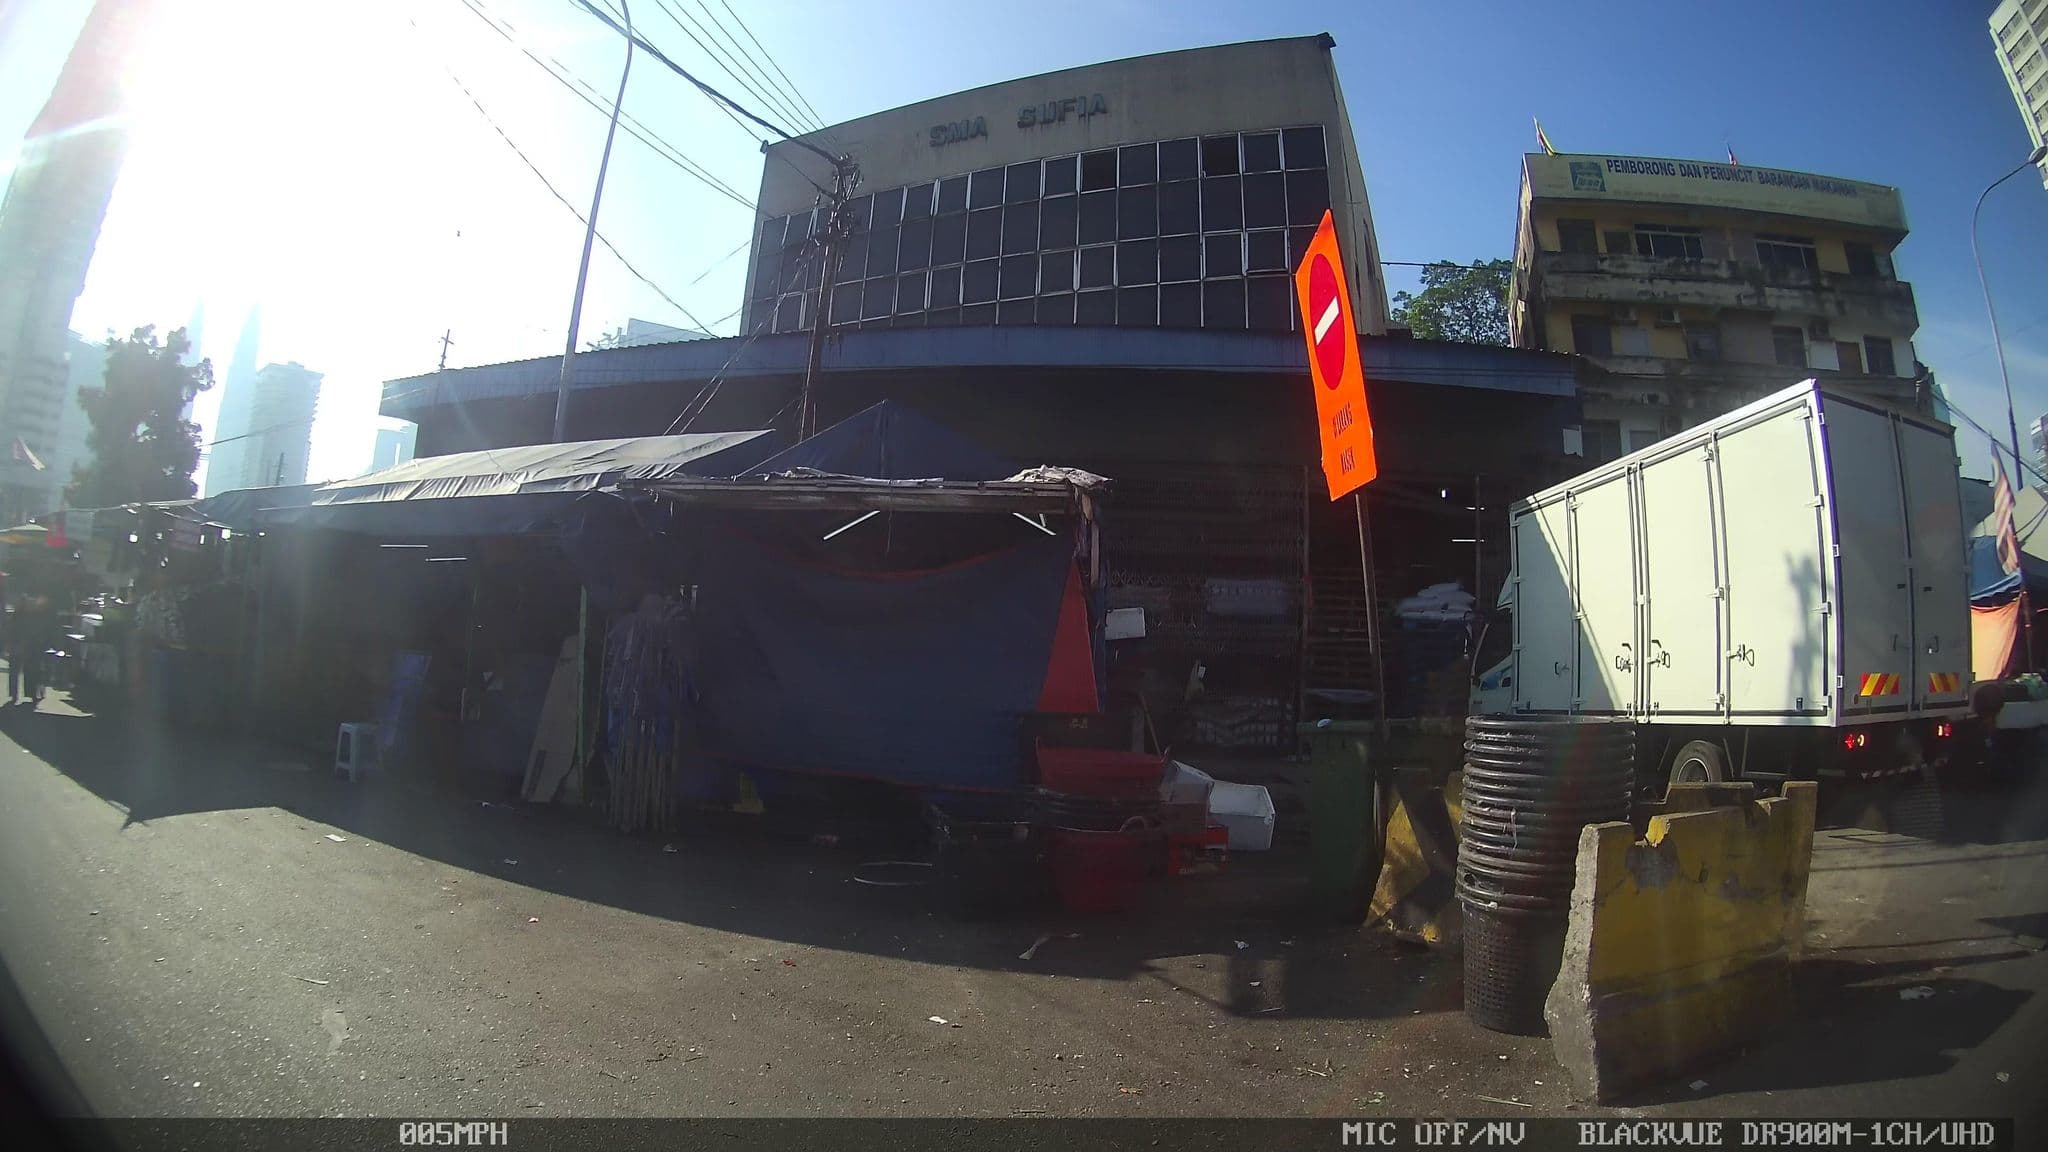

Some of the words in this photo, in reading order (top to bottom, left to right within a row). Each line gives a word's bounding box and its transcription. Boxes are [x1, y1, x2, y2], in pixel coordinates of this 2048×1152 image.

[1016, 93, 1107, 129] SUFIA
[1606, 159, 1676, 176] PEMBORONG
[1679, 163, 1702, 179] DAN
[1703, 166, 1754, 183] PERUNCIT
